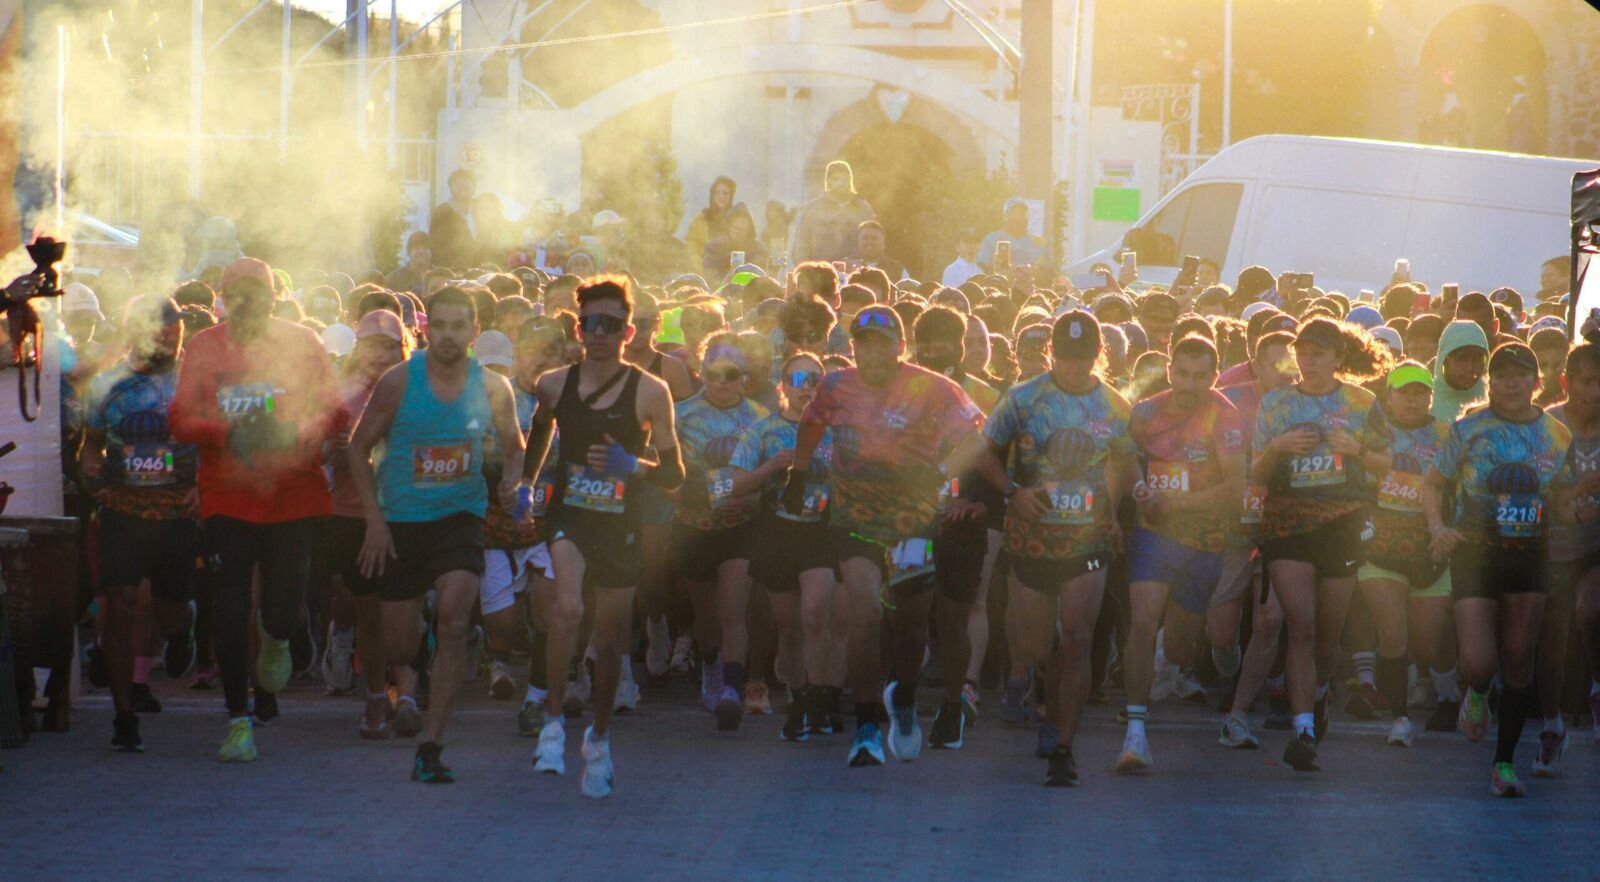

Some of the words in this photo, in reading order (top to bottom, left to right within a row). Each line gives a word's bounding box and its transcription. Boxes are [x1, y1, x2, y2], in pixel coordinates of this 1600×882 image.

[222, 396, 262, 412] 1771
[124, 457, 164, 471] 1946
[422, 459, 457, 473] 980
[1291, 456, 1334, 473] 1297
[568, 477, 615, 497] 2202
[714, 479, 733, 494] 53
[1149, 474, 1180, 489] 236
[1380, 481, 1418, 500] 2246
[1242, 496, 1265, 510] 12
[1496, 506, 1536, 522] 2218
